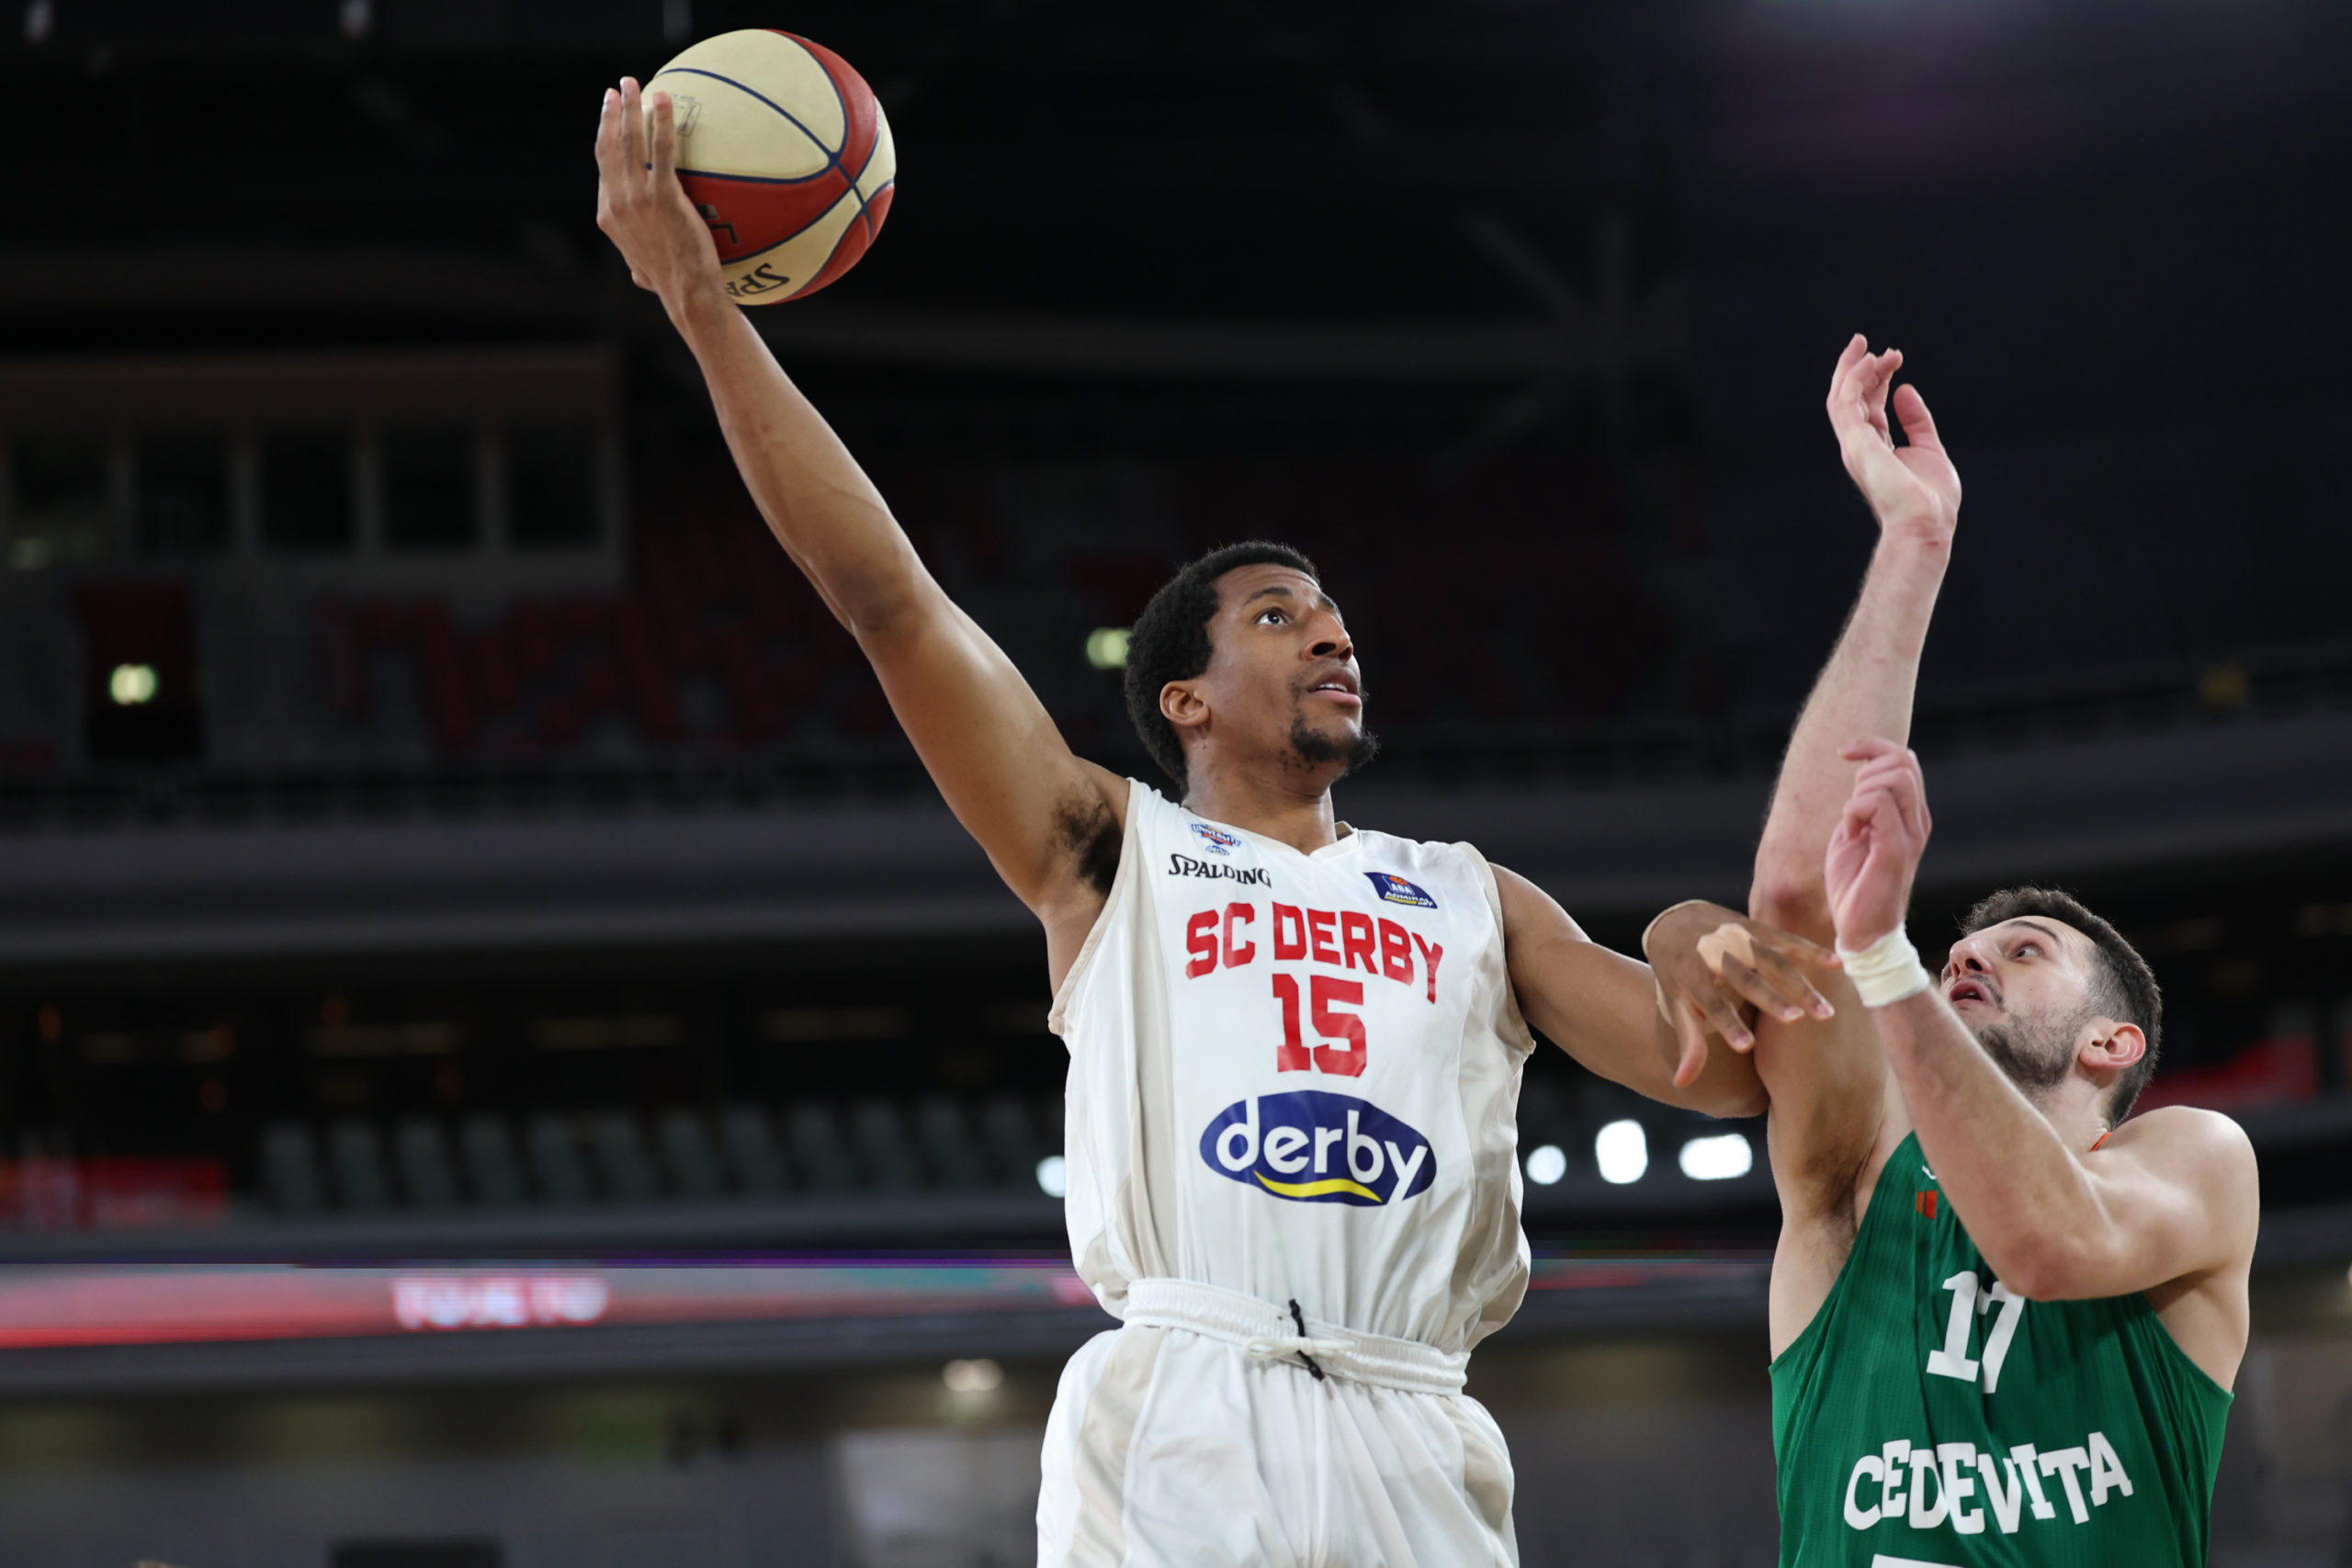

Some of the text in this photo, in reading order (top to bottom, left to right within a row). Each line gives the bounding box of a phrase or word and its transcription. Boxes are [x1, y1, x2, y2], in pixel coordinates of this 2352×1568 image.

[1169, 853, 1272, 888] SPALDING
[1191, 823, 1241, 847] UNIVERSITY
[1390, 883, 1414, 895] ABA
[1185, 901, 1443, 1004] SC DERBY
[1272, 973, 1367, 1077] 15
[1216, 1096, 1429, 1205] derby
[1926, 1270, 2025, 1393] 17
[1843, 1431, 2134, 1535] CEDEVITA
